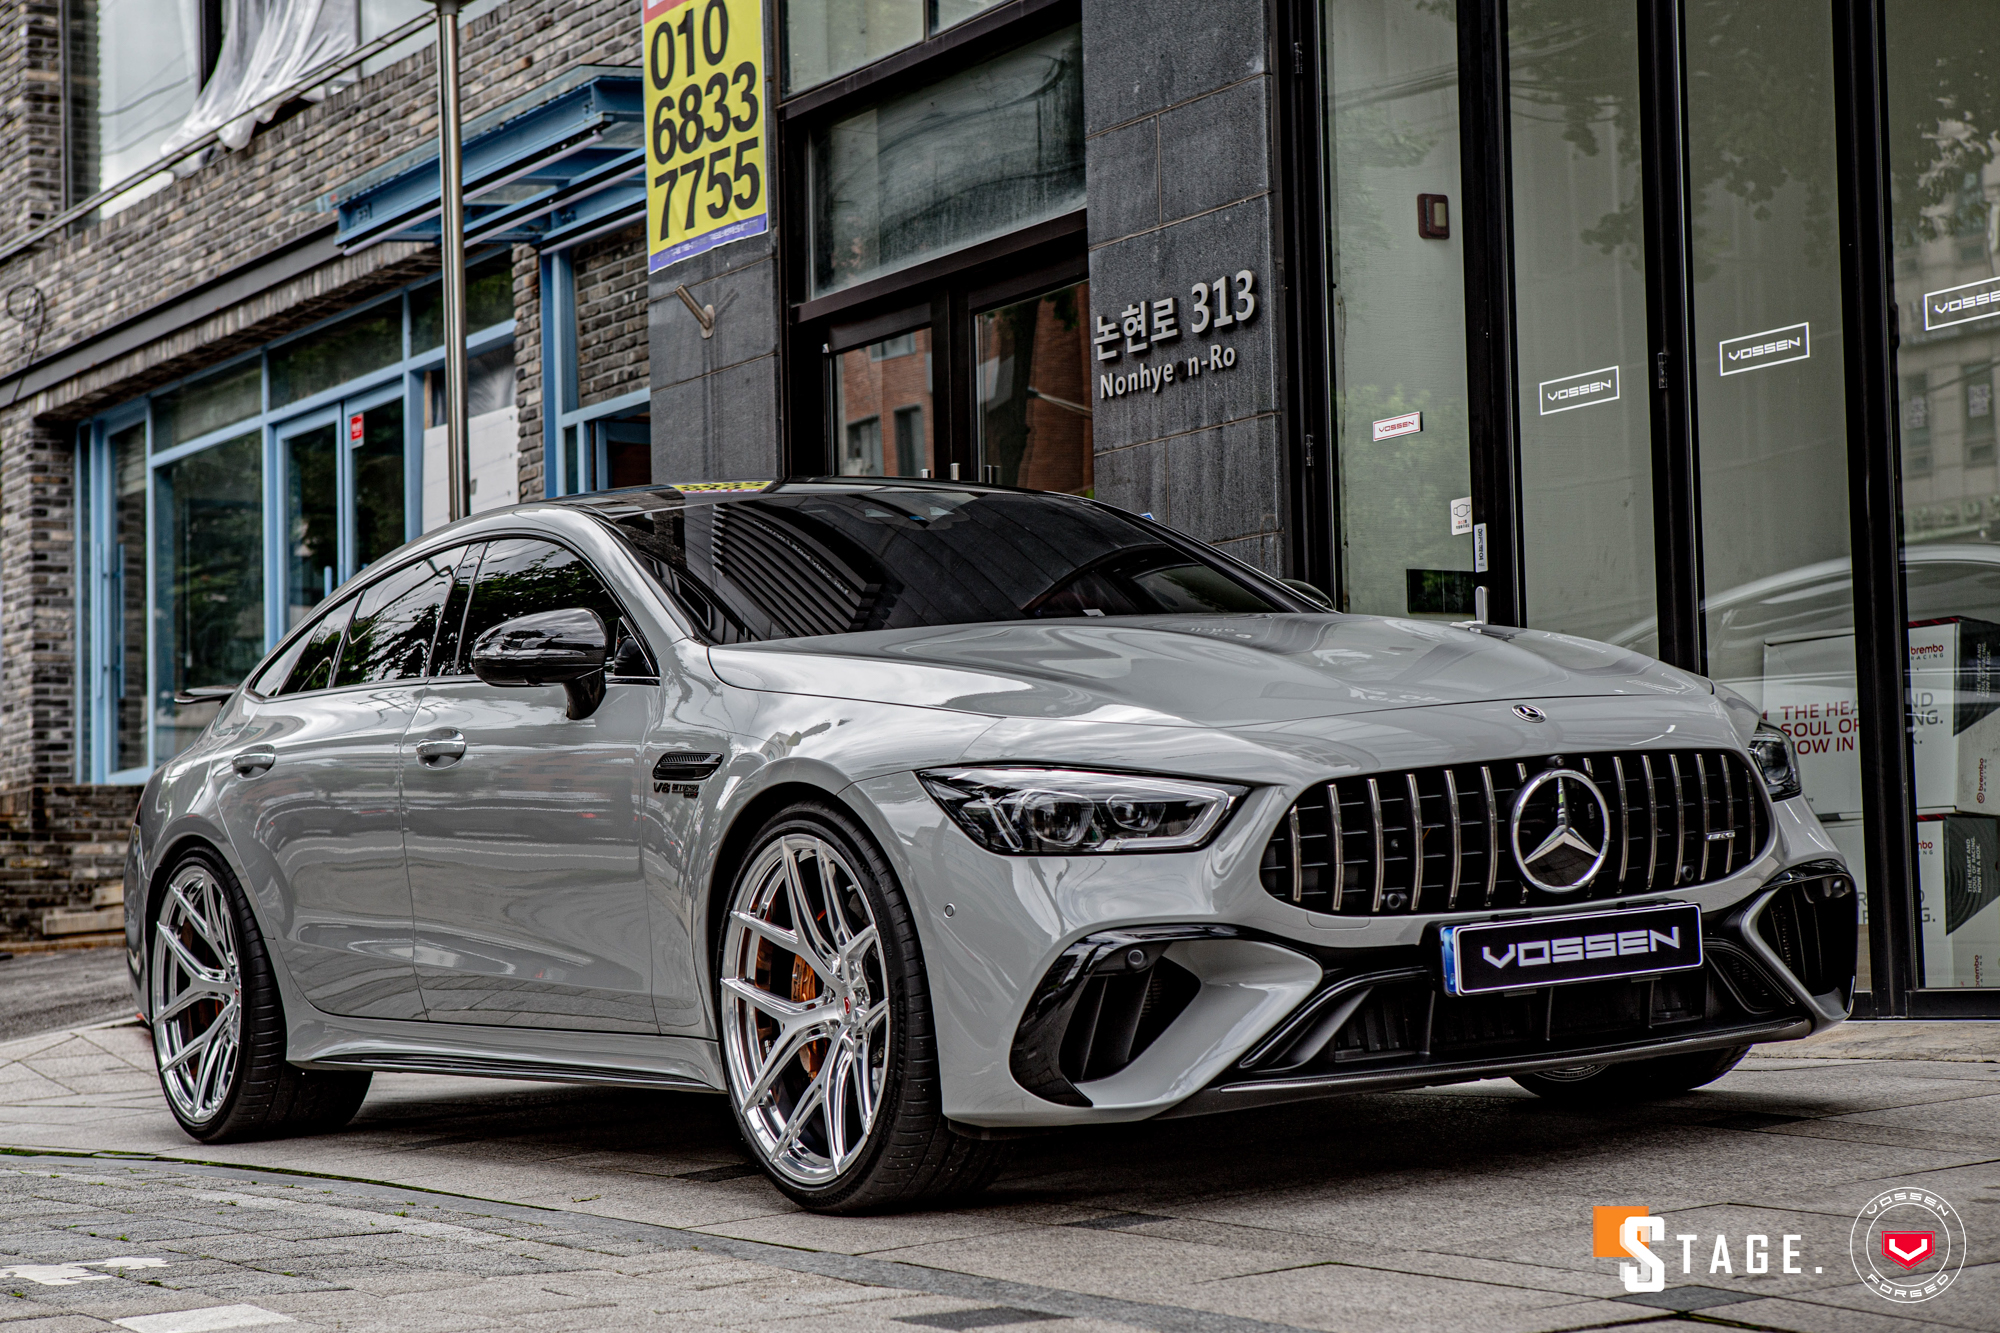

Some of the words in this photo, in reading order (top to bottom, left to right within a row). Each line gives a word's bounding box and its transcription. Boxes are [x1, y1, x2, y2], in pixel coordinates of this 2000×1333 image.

[651, 0, 729, 90] 010
[653, 61, 759, 165] 6833
[654, 136, 760, 241] 7755
[1094, 297, 1178, 361] 논현로
[1191, 269, 1256, 334] 313
[1728, 337, 1801, 361] VOSSEN
[1548, 379, 1612, 401] VOSSEN
[1378, 420, 1415, 433] VOSSEN
[1910, 643, 1944, 656] brembo
[1910, 653, 1944, 661] RACING
[1780, 703, 1819, 720] THE
[1781, 721, 1833, 737] SOUL
[1836, 736, 1854, 752] IN
[1972, 864, 1976, 874] OF
[1977, 867, 1981, 875] IN
[1482, 926, 1681, 969] VOSSEN
